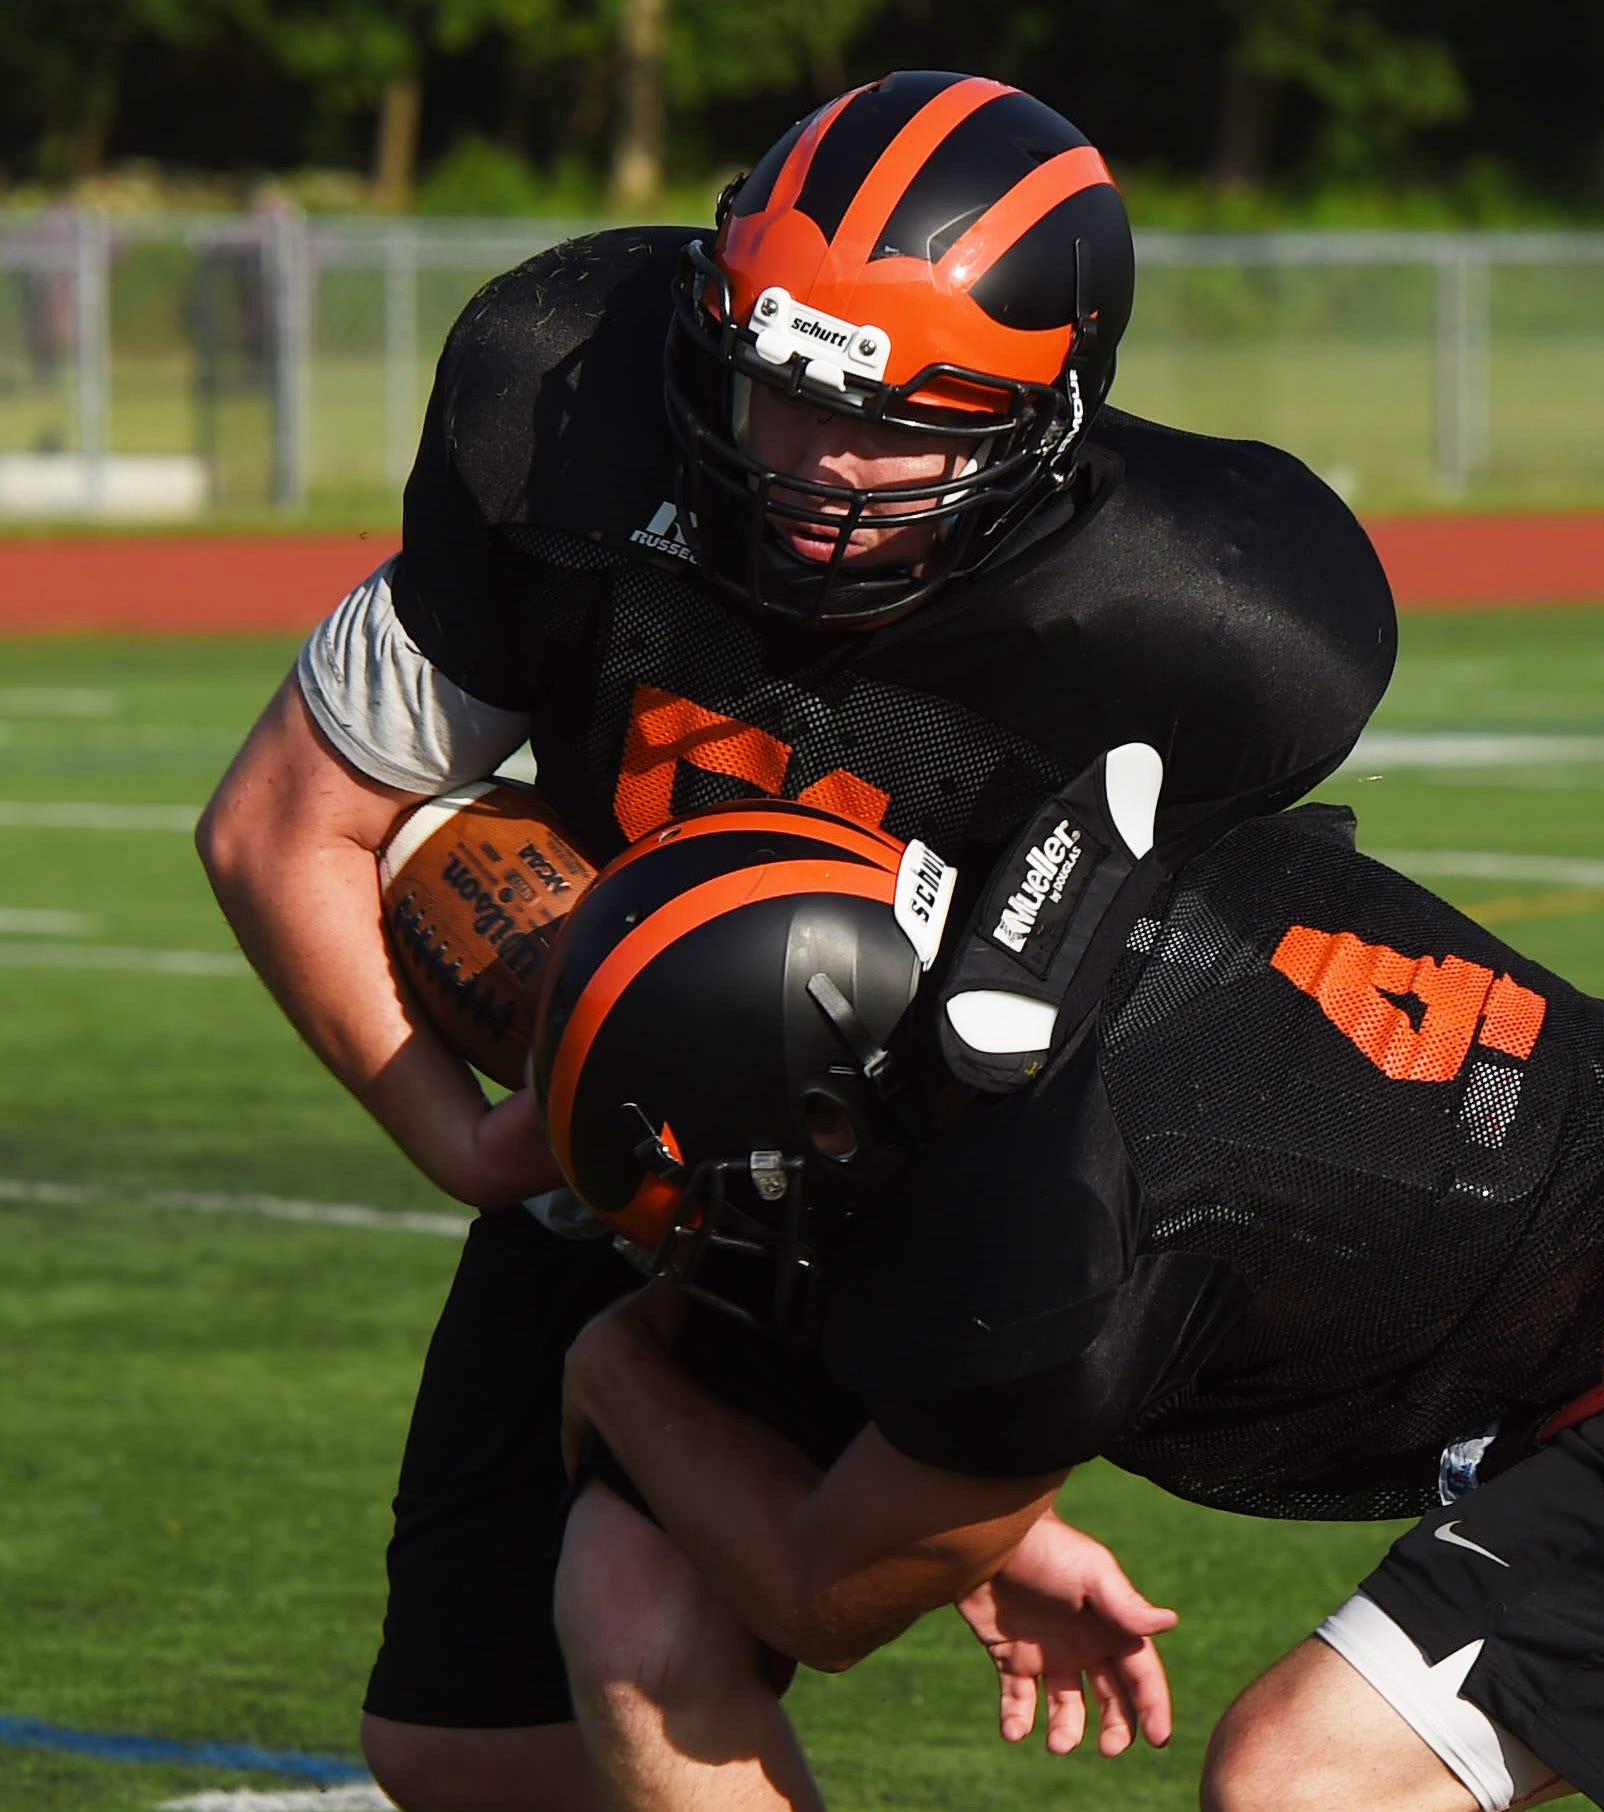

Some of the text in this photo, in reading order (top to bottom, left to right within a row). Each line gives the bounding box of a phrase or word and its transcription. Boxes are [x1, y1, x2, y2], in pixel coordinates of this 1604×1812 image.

[791, 317, 847, 347] schutt
[518, 842, 570, 894] NCAA
[1001, 820, 1071, 934] Mueller
[1053, 846, 1081, 892] DOUGLAS
[441, 852, 542, 981] Wilson
